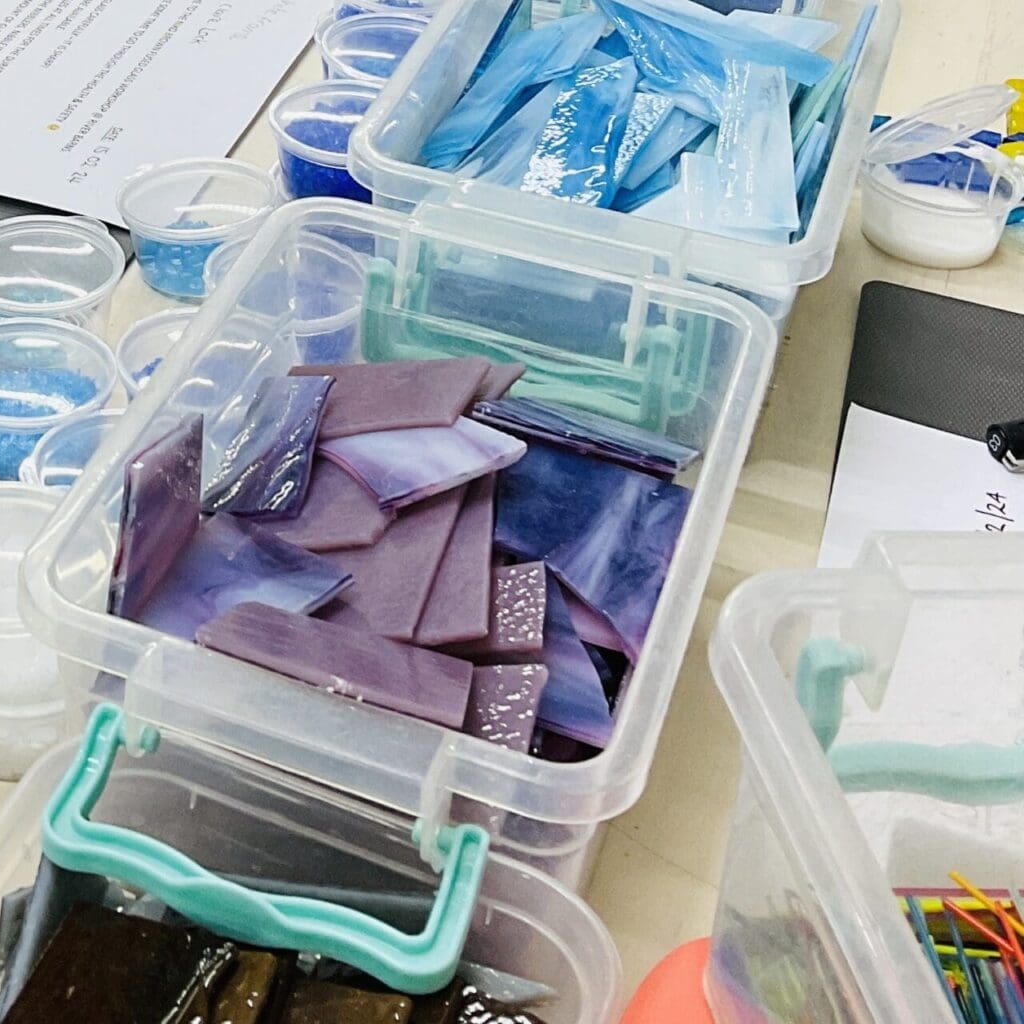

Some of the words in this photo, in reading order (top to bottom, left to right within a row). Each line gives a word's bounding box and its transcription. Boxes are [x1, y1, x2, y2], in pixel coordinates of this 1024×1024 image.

[28, 21, 49, 36] TIMES
[137, 17, 157, 29] TIME
[101, 44, 133, 70] THROUGH
[135, 50, 158, 67] FUSED
[121, 66, 144, 83] GLASS
[75, 78, 102, 99] HEALTH
[95, 82, 130, 112] WORKSHOP
[54, 103, 80, 123] SAFETY
[76, 118, 98, 135] RIVER
